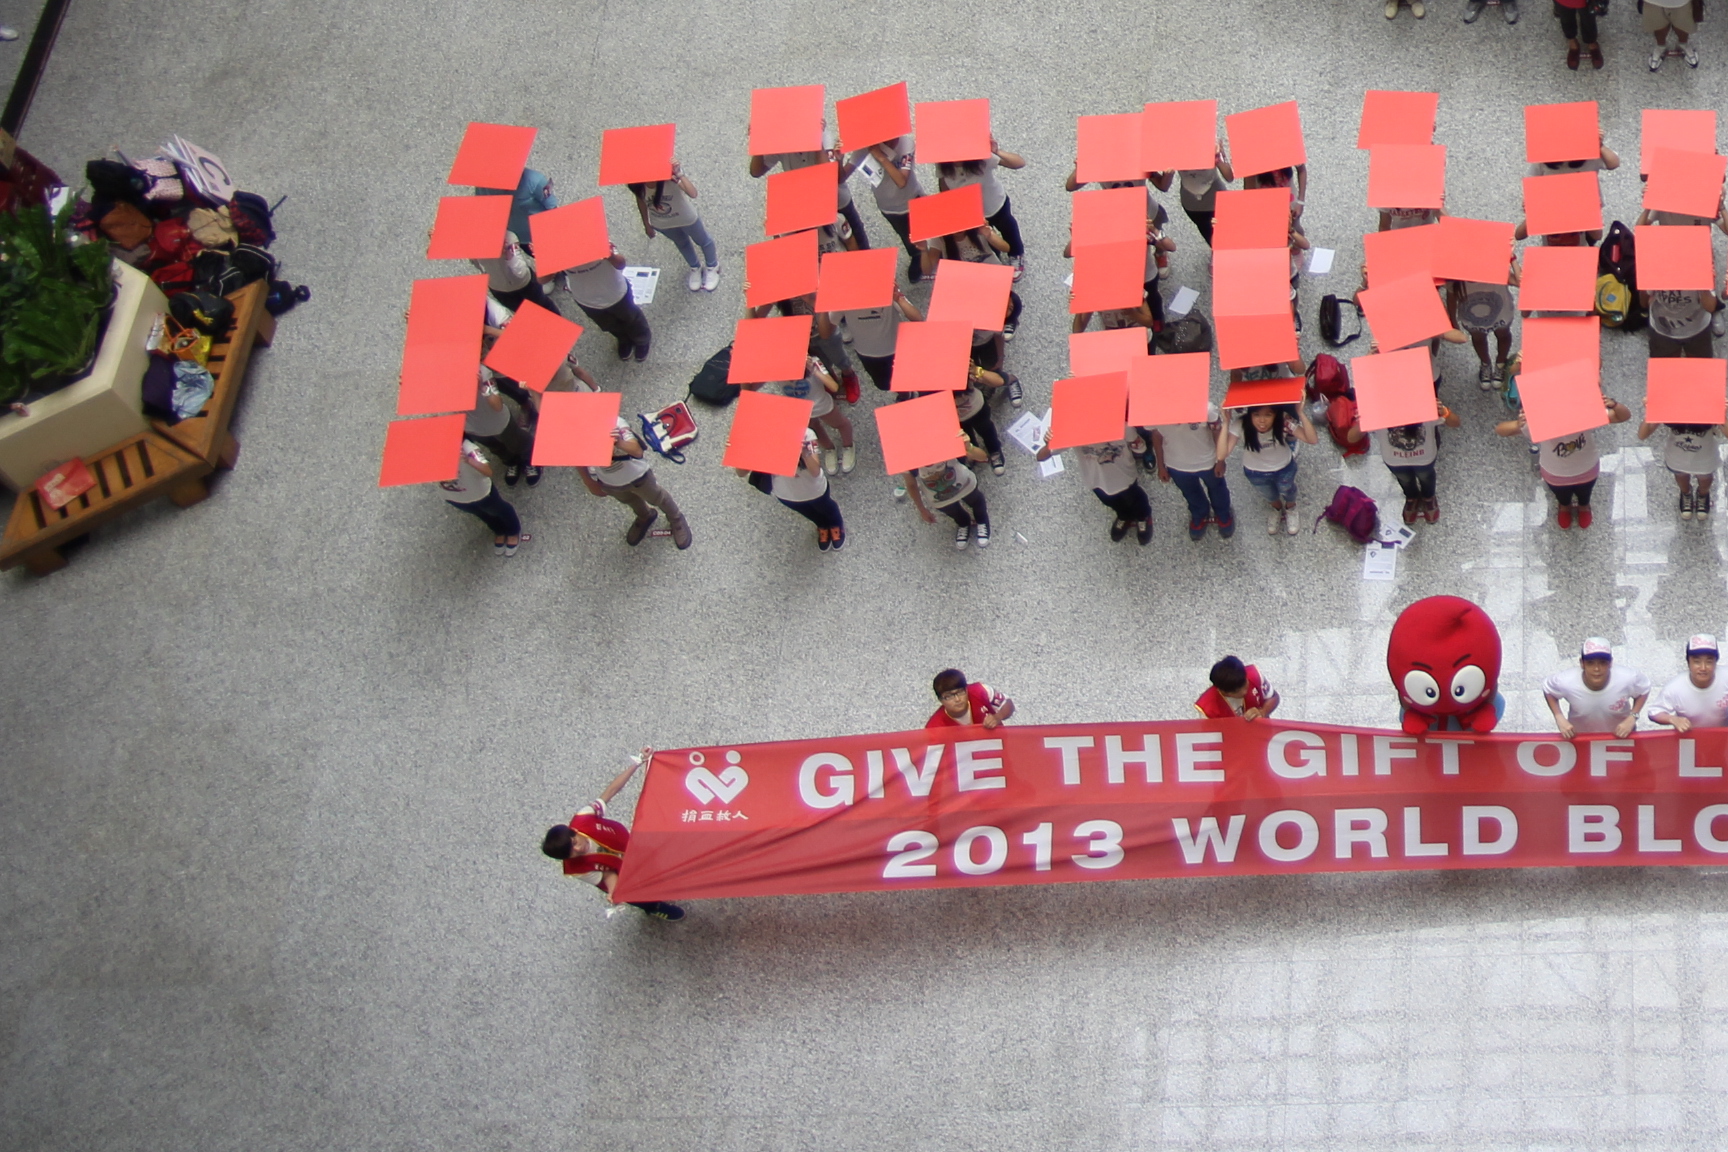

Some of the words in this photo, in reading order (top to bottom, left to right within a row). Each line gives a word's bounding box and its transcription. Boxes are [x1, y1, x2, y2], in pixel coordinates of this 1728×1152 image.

[798, 738, 1006, 810] GIVE
[1043, 732, 1225, 785] THE
[1267, 730, 1475, 779] GIFT
[1516, 739, 1634, 777] OF
[681, 809, 750, 824] 捐血救人
[882, 819, 1124, 878] 2013
[1171, 805, 1518, 864] WORLD
